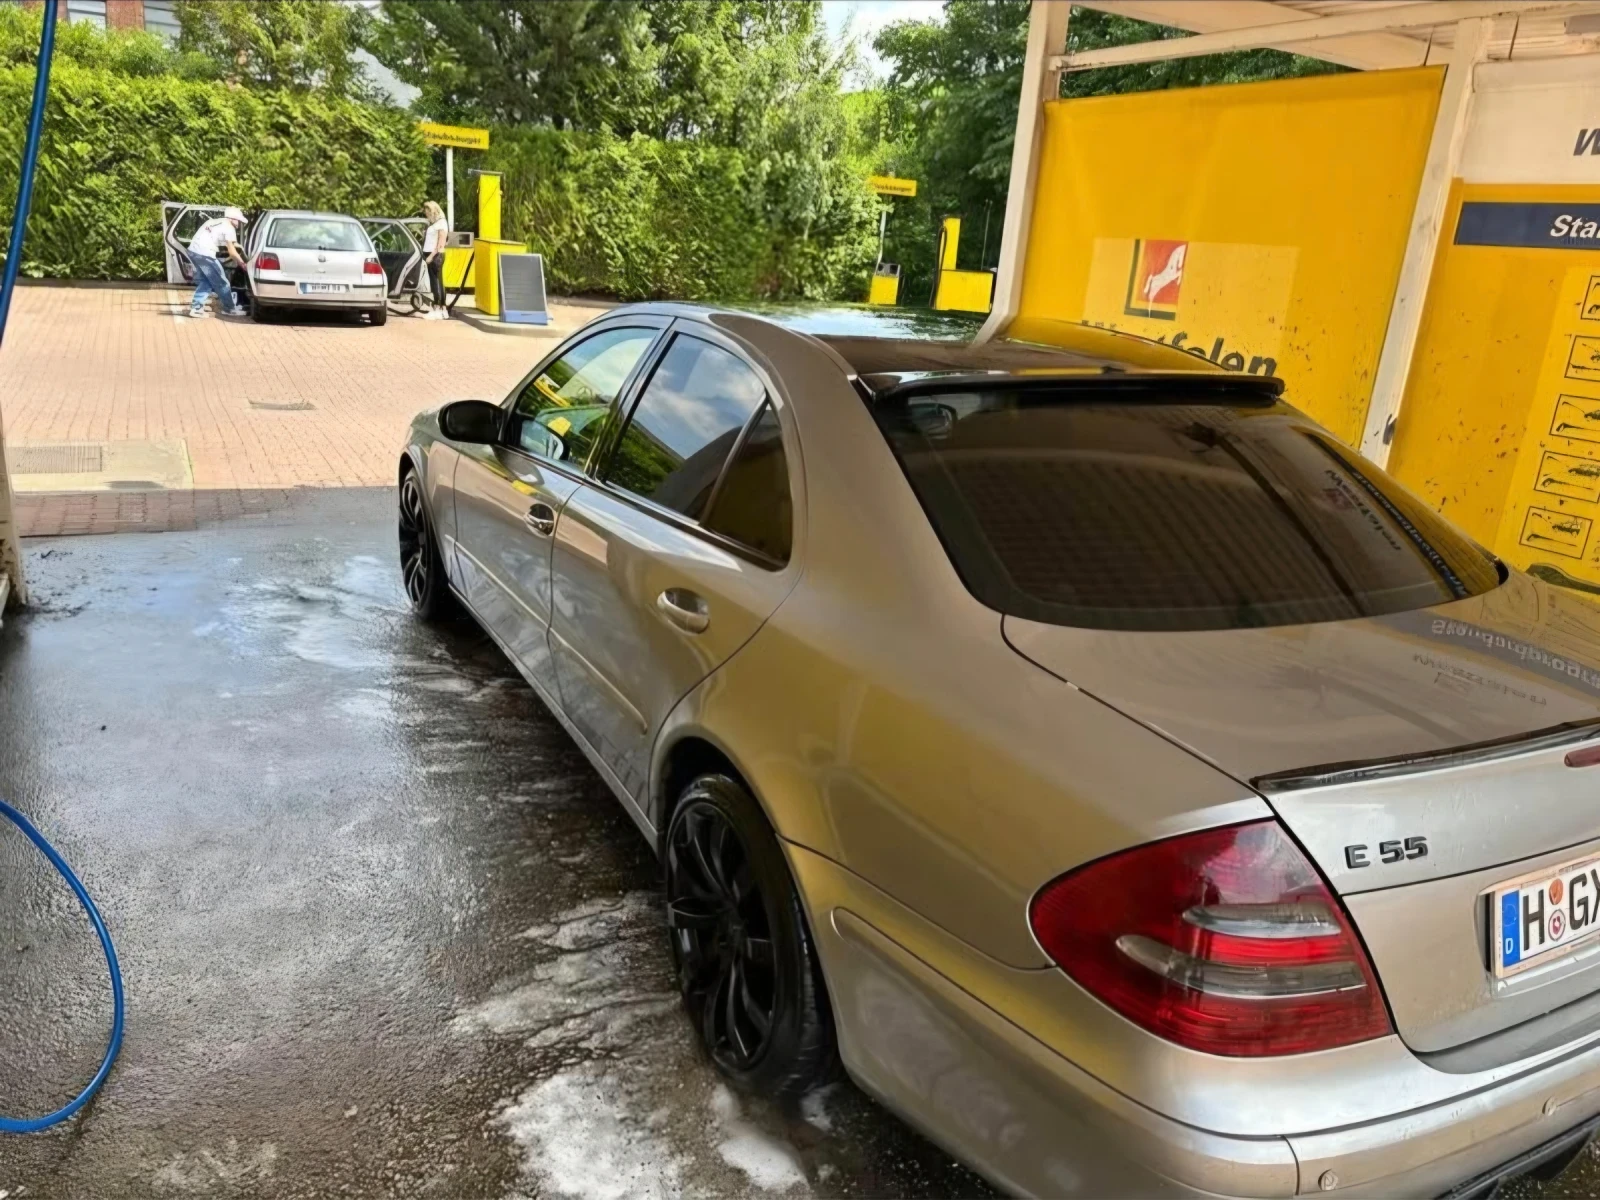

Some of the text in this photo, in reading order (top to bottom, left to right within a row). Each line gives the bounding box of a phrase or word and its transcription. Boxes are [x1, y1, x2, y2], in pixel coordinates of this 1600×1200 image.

[1550, 214, 1600, 239] Sta
[1344, 836, 1429, 869] E 55
[1522, 889, 1545, 952] H
[1505, 938, 1514, 955] D
